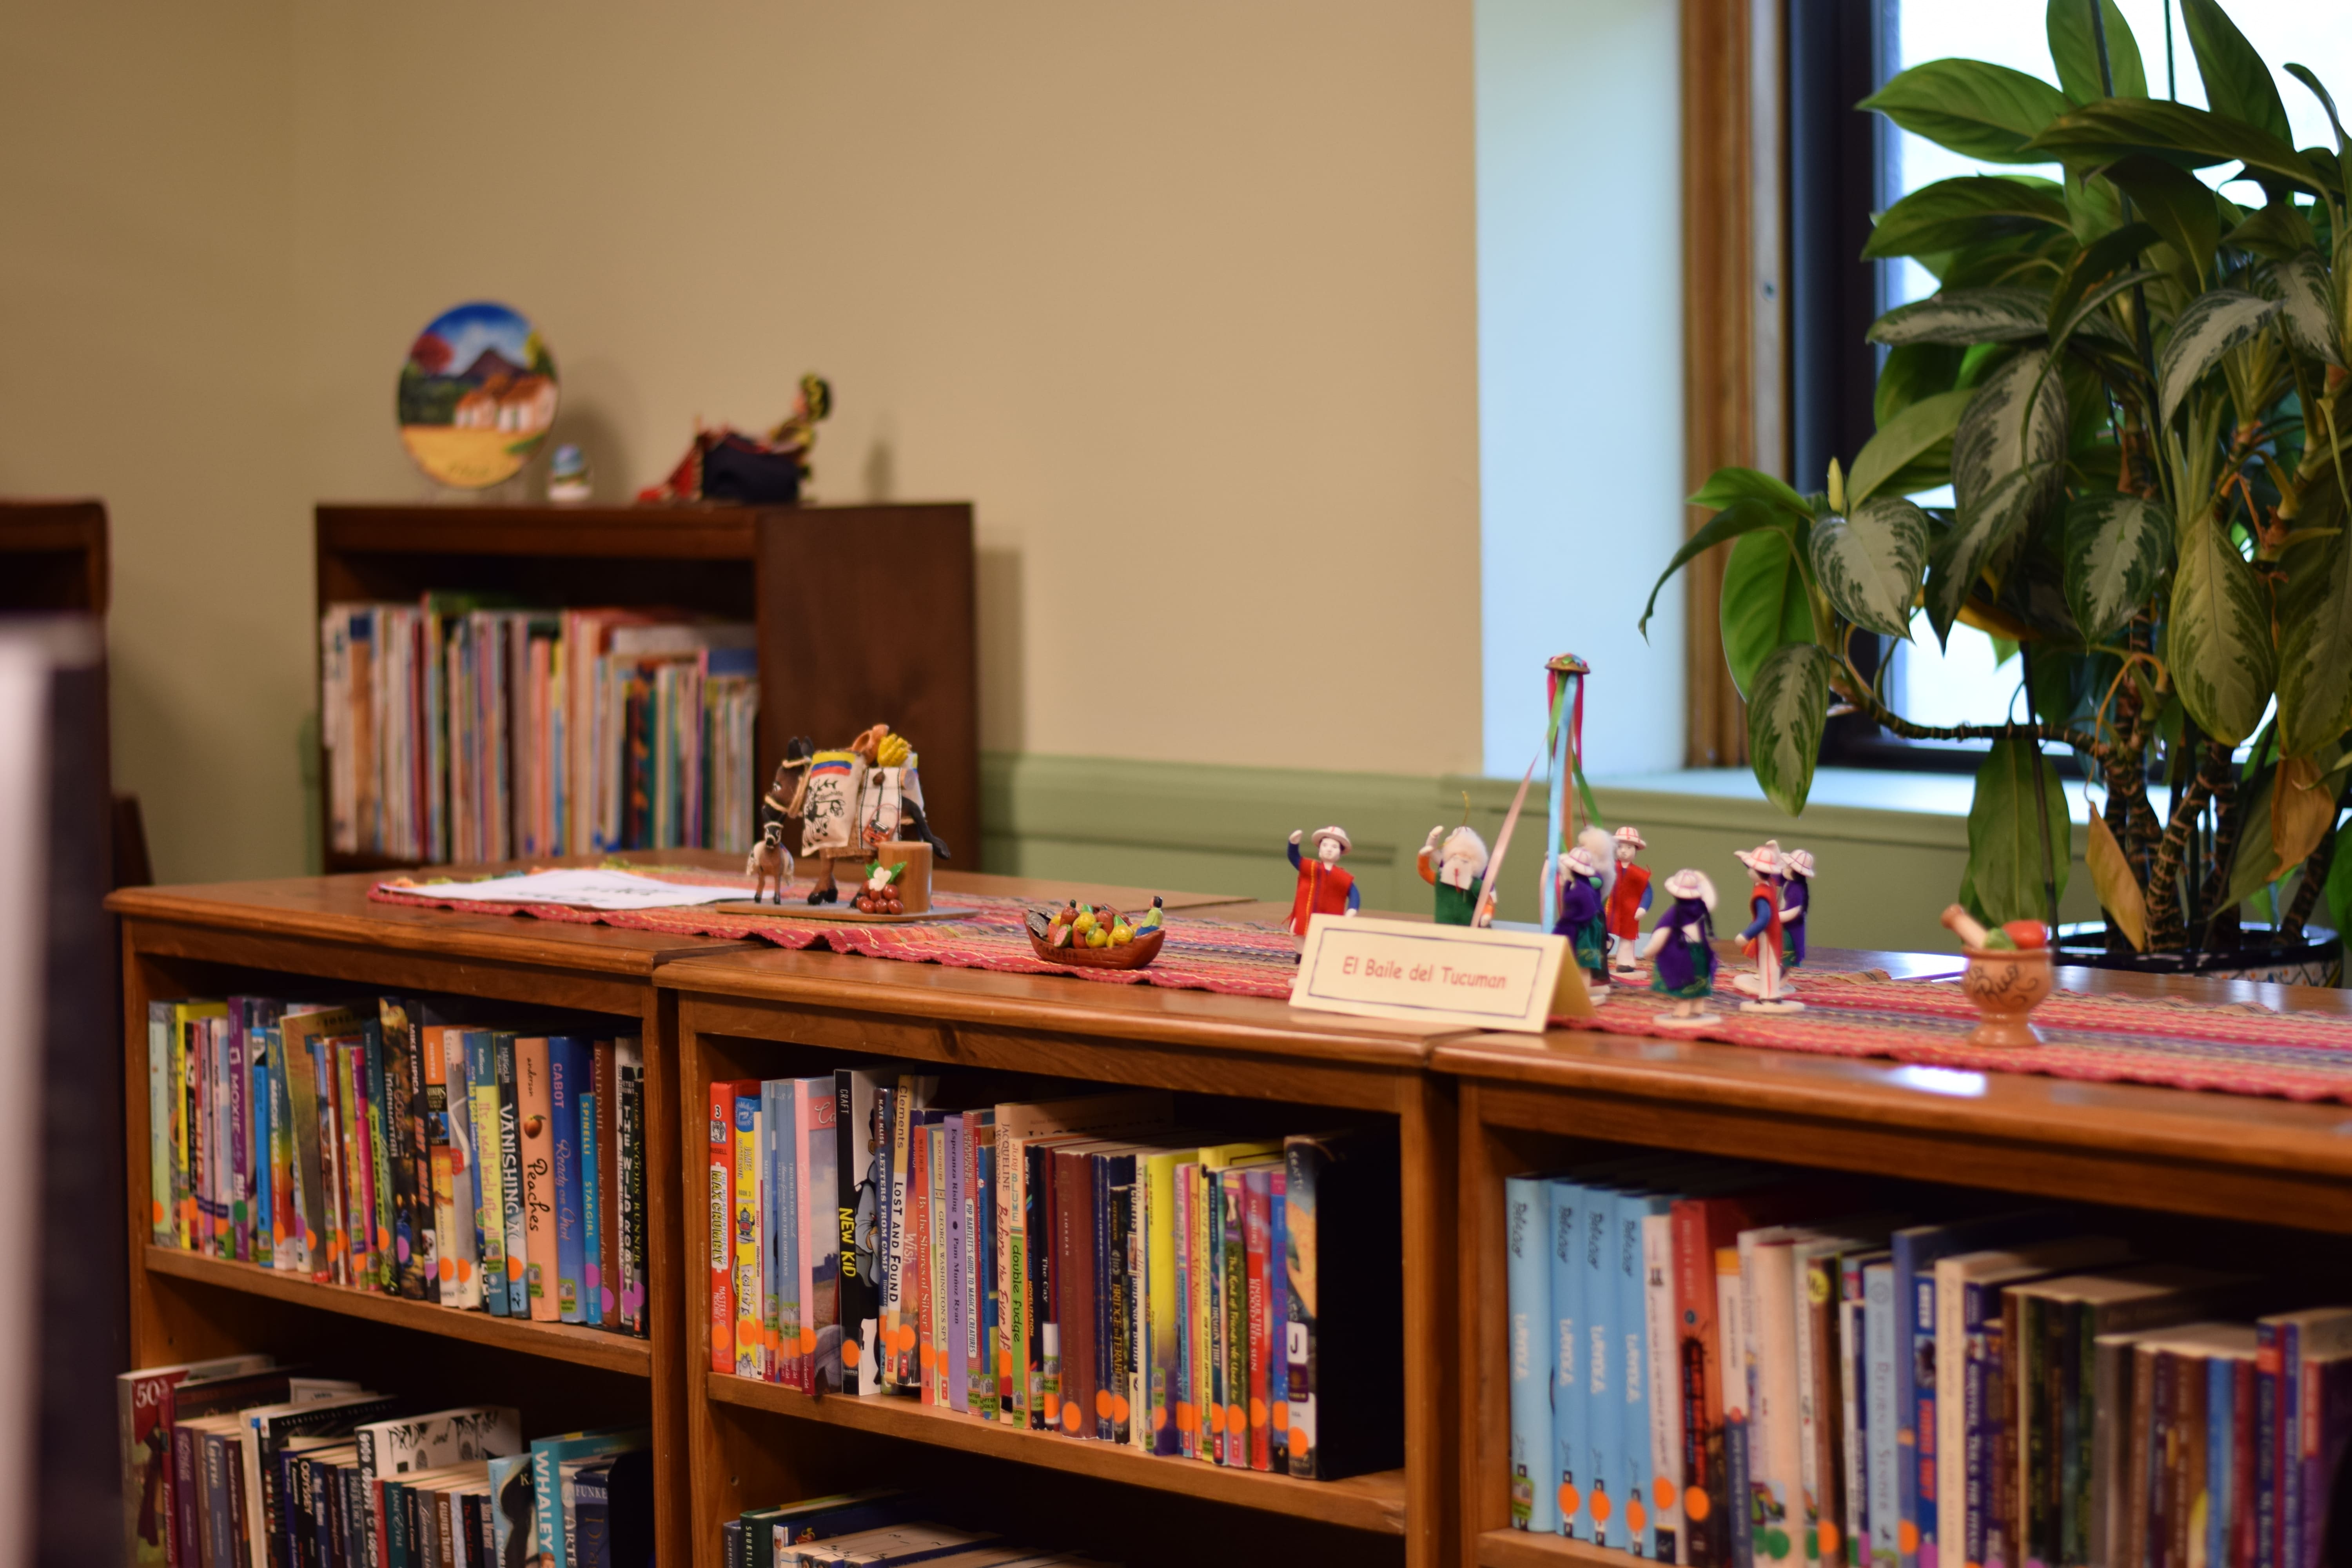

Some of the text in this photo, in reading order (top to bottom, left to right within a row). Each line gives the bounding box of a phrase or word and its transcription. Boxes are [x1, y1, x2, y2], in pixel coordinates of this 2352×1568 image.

[1343, 957, 1506, 989] El Baile del Tucuman
[527, 1057, 536, 1097] anderson
[553, 1063, 564, 1109] CABOT
[230, 1073, 241, 1134] MOXIE
[840, 1089, 849, 1114] CRAFT
[897, 1085, 908, 1149] Clements
[500, 1103, 519, 1214] VANISHING
[744, 1146, 752, 1171] JAMES
[1001, 1123, 1010, 1192] JACQUELINE
[527, 1158, 550, 1232] Peaches
[555, 1139, 575, 1241] Ready Not
[623, 1157, 632, 1212] WILD
[917, 1196, 926, 1209] By
[584, 1181, 594, 1238] STARGIRL
[712, 1171, 722, 1265] MAX CRUMBLY
[838, 1207, 855, 1243] NEW
[919, 1214, 927, 1232] the
[1191, 1192, 1200, 1248] Remember
[891, 1221, 900, 1249] AND
[903, 1232, 918, 1264] Wish
[998, 1202, 1009, 1258] Before
[624, 1220, 633, 1292] ROBOT
[722, 1256, 728, 1266] OF
[920, 1235, 929, 1275] Shores
[998, 1263, 1007, 1283] the
[1228, 1256, 1238, 1272] The
[920, 1278, 929, 1289] of
[968, 1277, 975, 1285] TO
[1012, 1245, 1023, 1343] double fudge
[1191, 1280, 1200, 1314] Name
[921, 1293, 930, 1327] Silver
[999, 1289, 1009, 1325] Ever
[1112, 1283, 1123, 1328] BRIDGE
[1249, 1278, 1258, 1371] BLOOD-RED SUN
[1229, 1311, 1239, 1343] Friends
[535, 1450, 554, 1551] WHALEY
[575, 1483, 608, 1500] FUNKE
